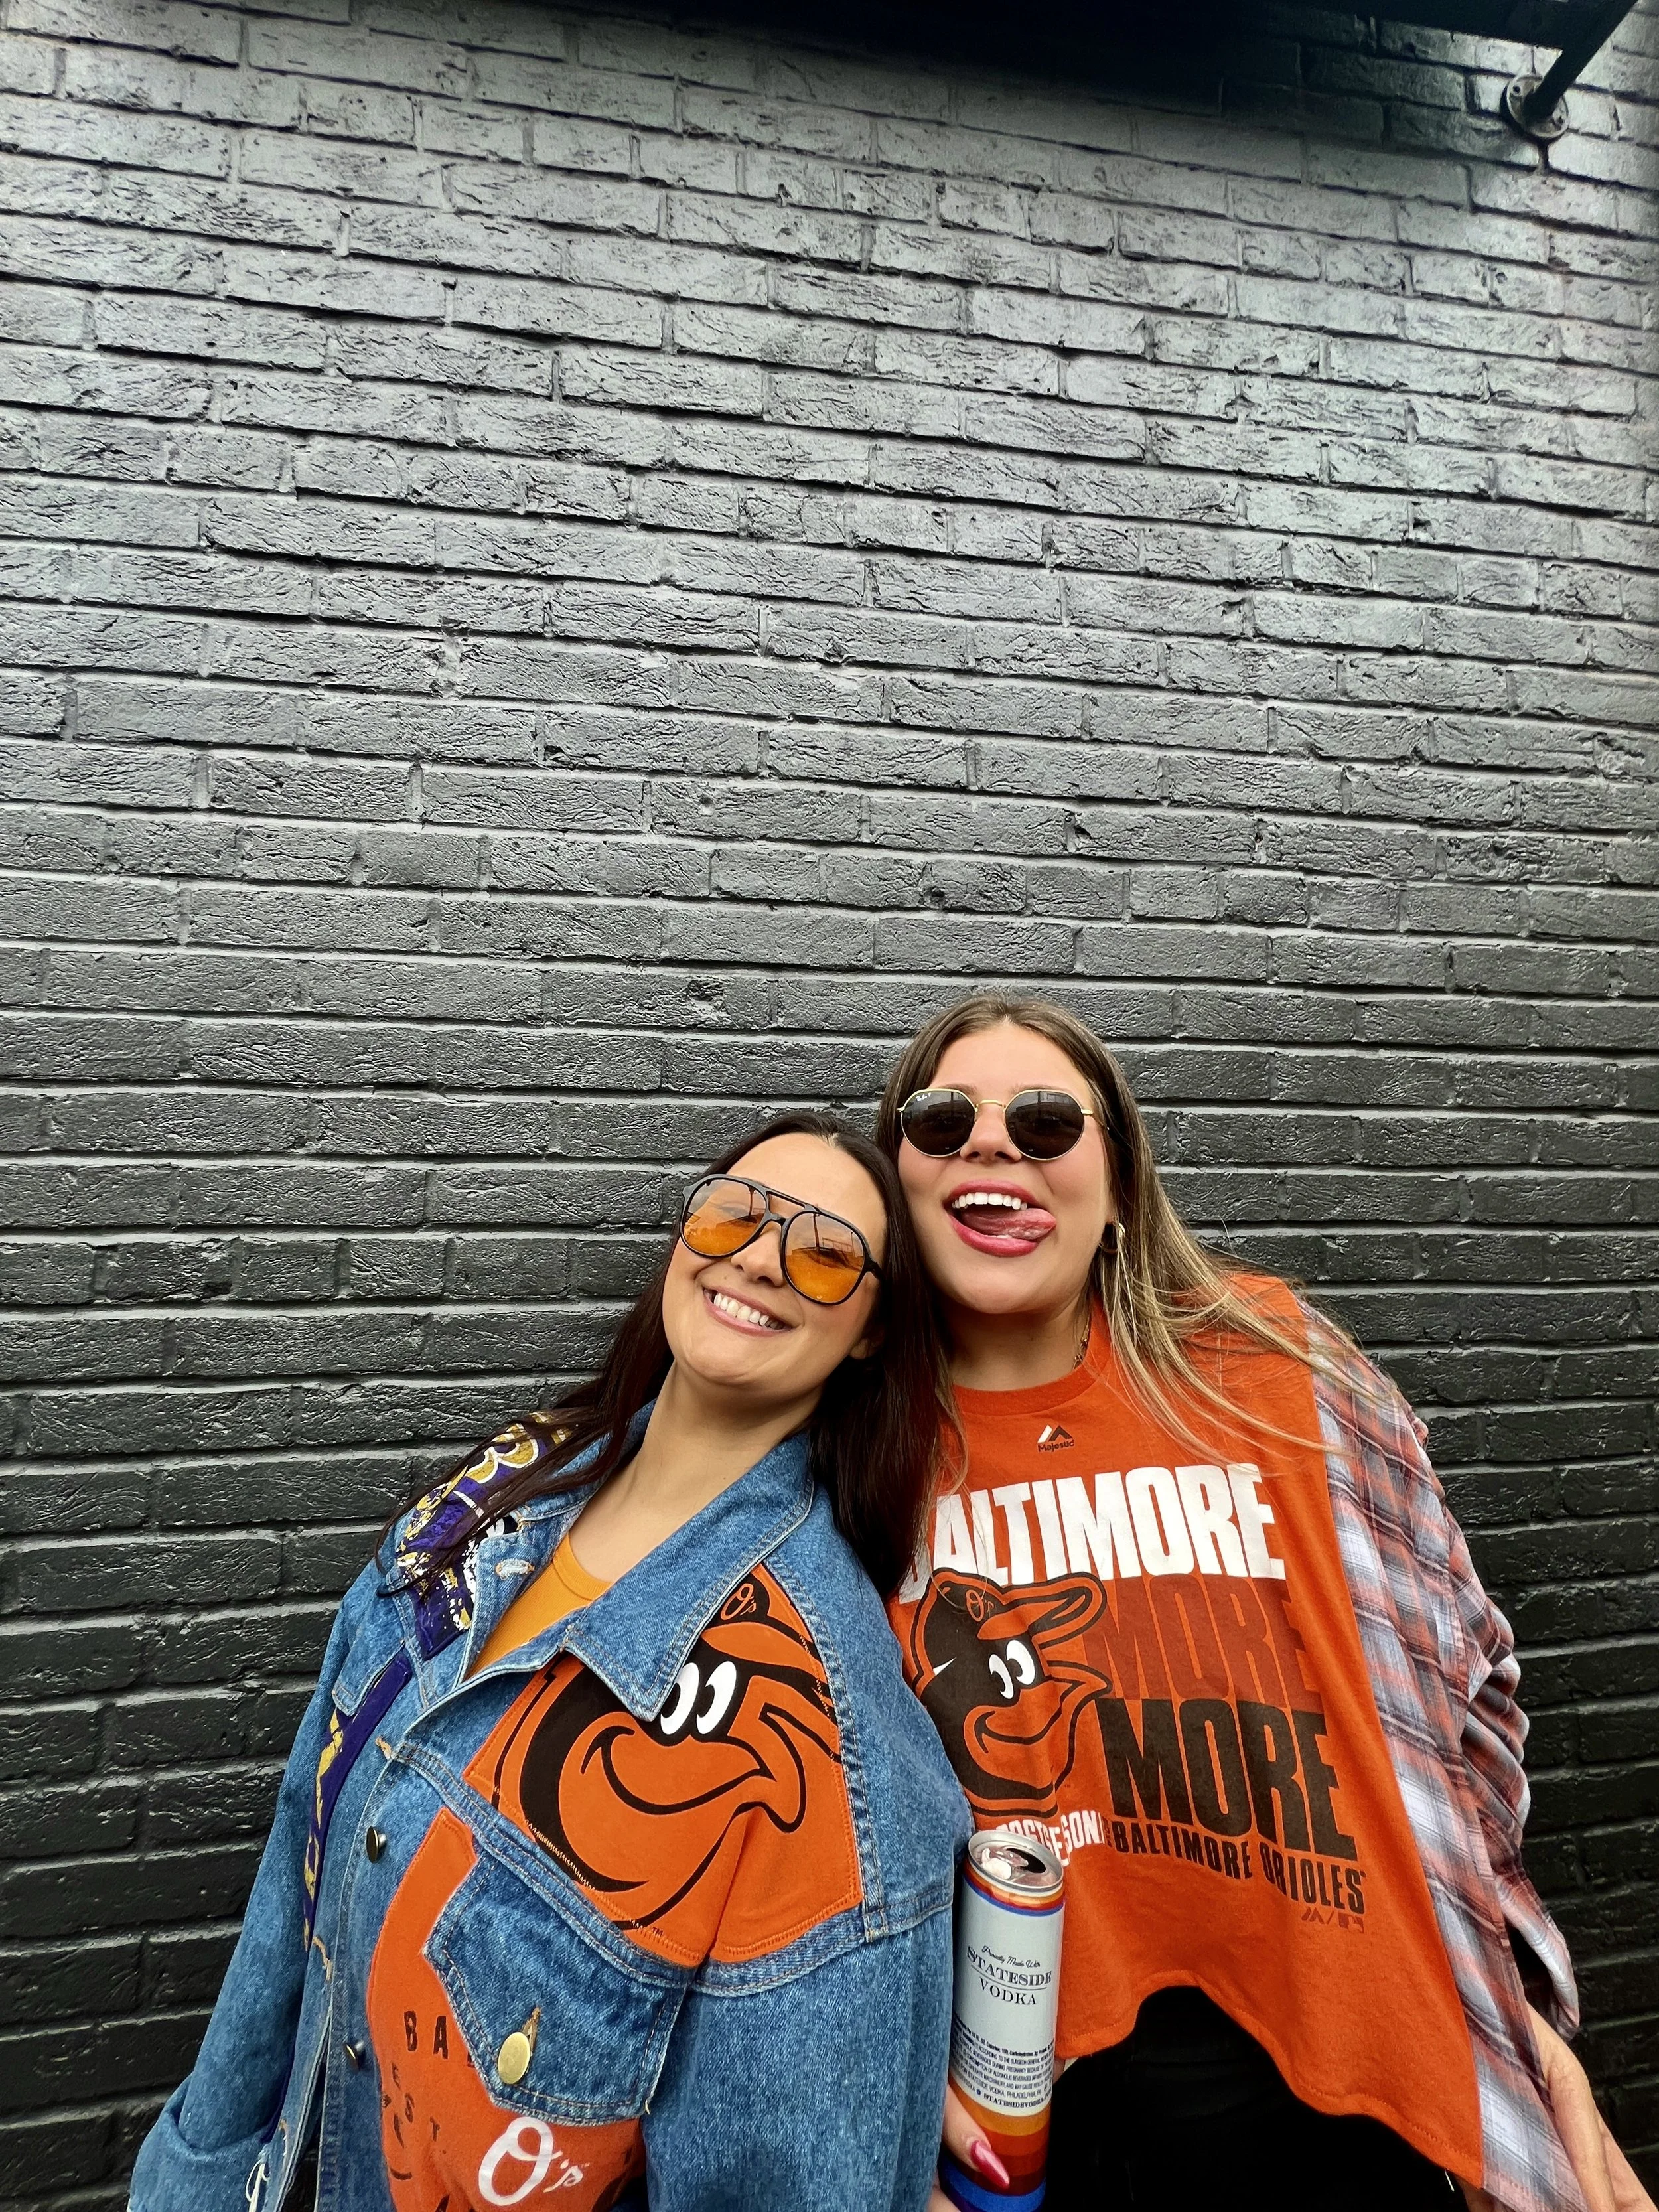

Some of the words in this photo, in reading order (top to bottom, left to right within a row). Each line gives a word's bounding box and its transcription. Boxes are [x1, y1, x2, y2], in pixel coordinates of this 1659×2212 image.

[1038, 1439, 1074, 1452] Majestic
[720, 1583, 757, 1620] O's
[1082, 1574, 1325, 1714] MORE
[1096, 1698, 1357, 1861] MORE
[1112, 1821, 1253, 1879] BALTIMORE
[1260, 1842, 1366, 1914] ORIOLES
[967, 1946, 1052, 1986] STATESIDE
[979, 1977, 1037, 2005] VODKA
[478, 2116, 583, 2206] O's
